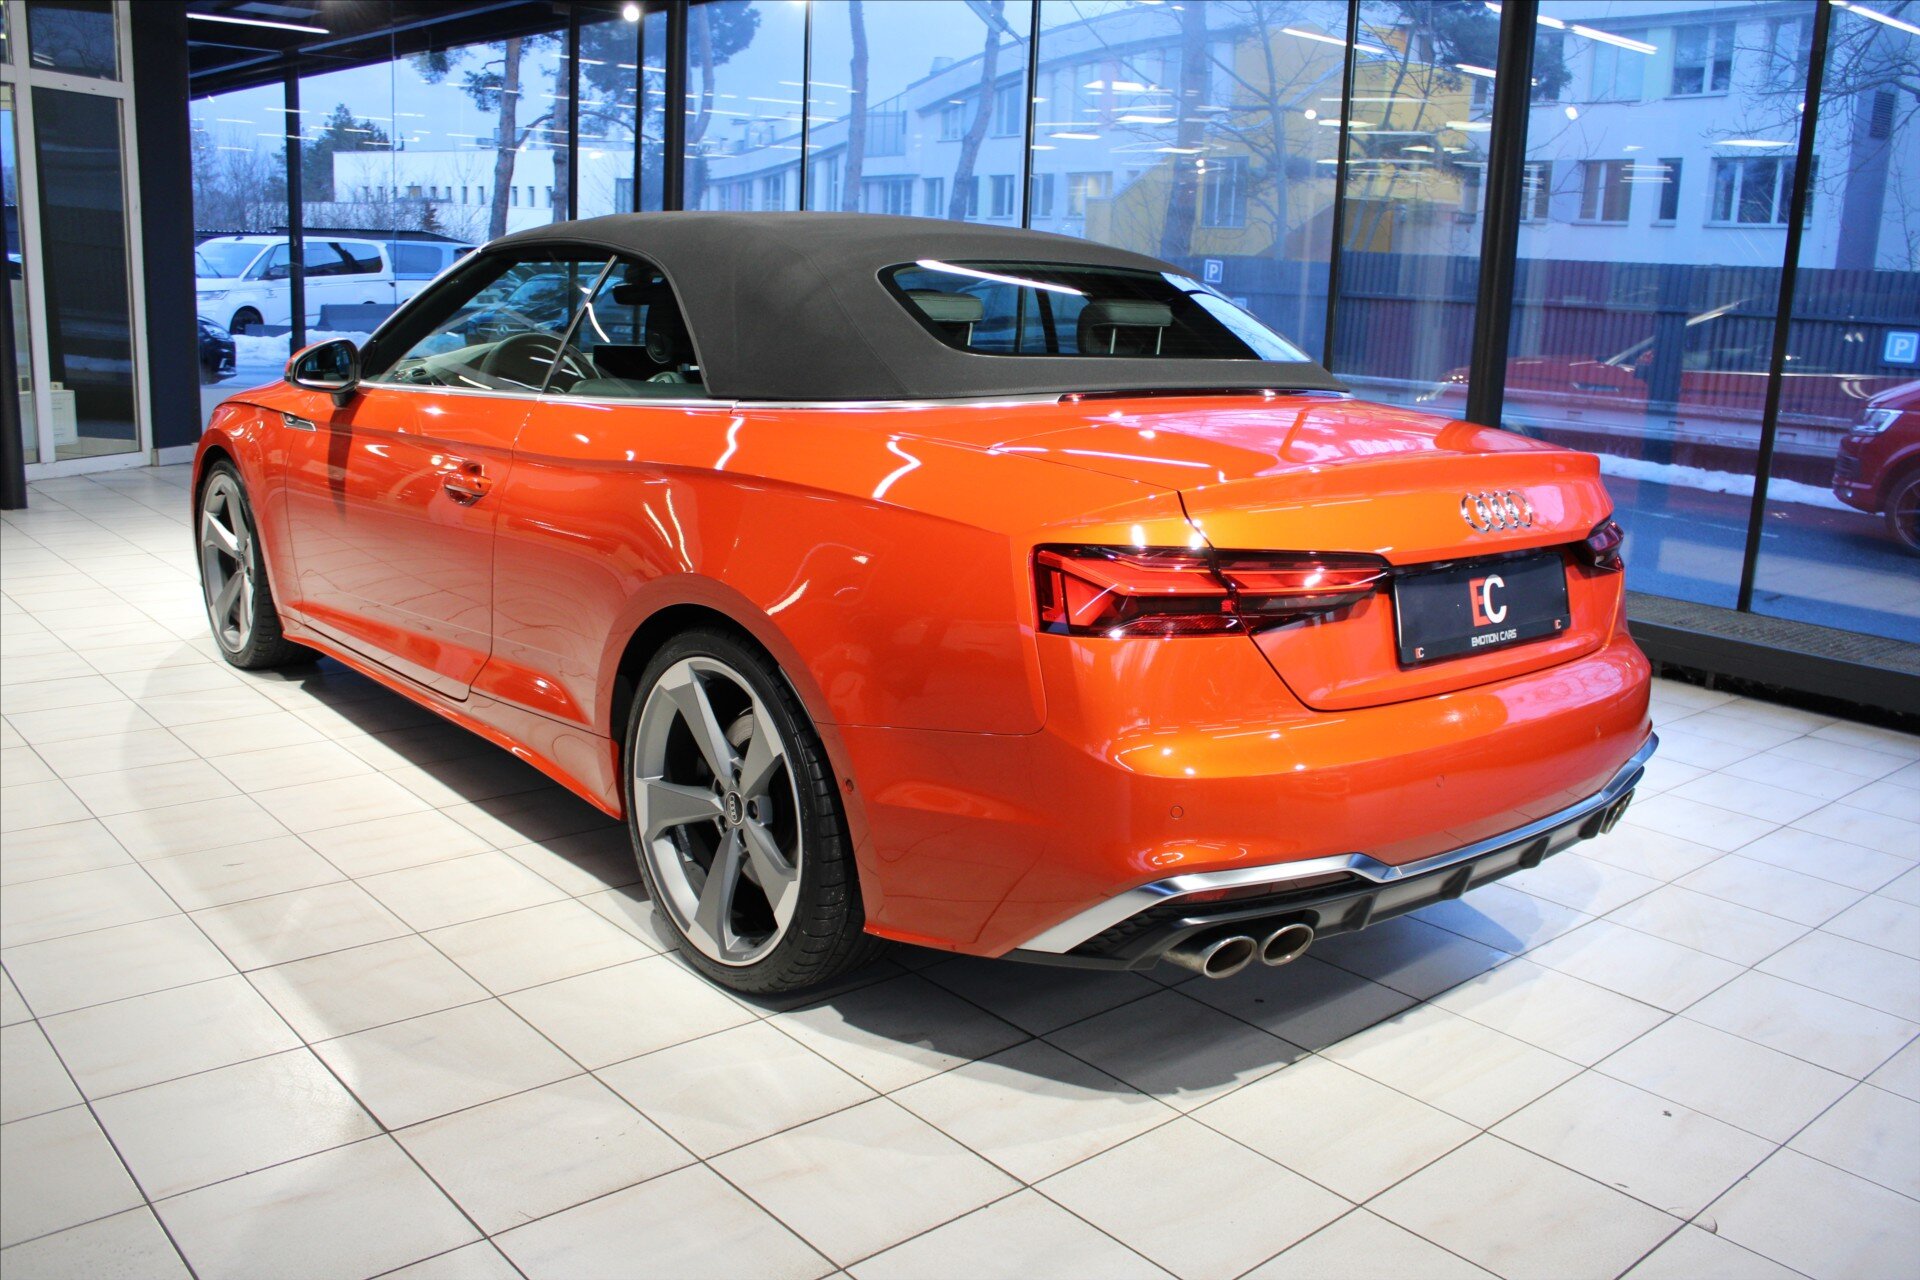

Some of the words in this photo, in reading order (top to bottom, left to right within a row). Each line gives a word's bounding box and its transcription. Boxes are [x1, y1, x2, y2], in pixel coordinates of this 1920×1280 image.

[1209, 264, 1219, 279] P
[1894, 338, 1909, 356] P
[1469, 574, 1507, 627] EC
[1471, 632, 1499, 647] EMOTION
[1500, 629, 1517, 641] CARS
